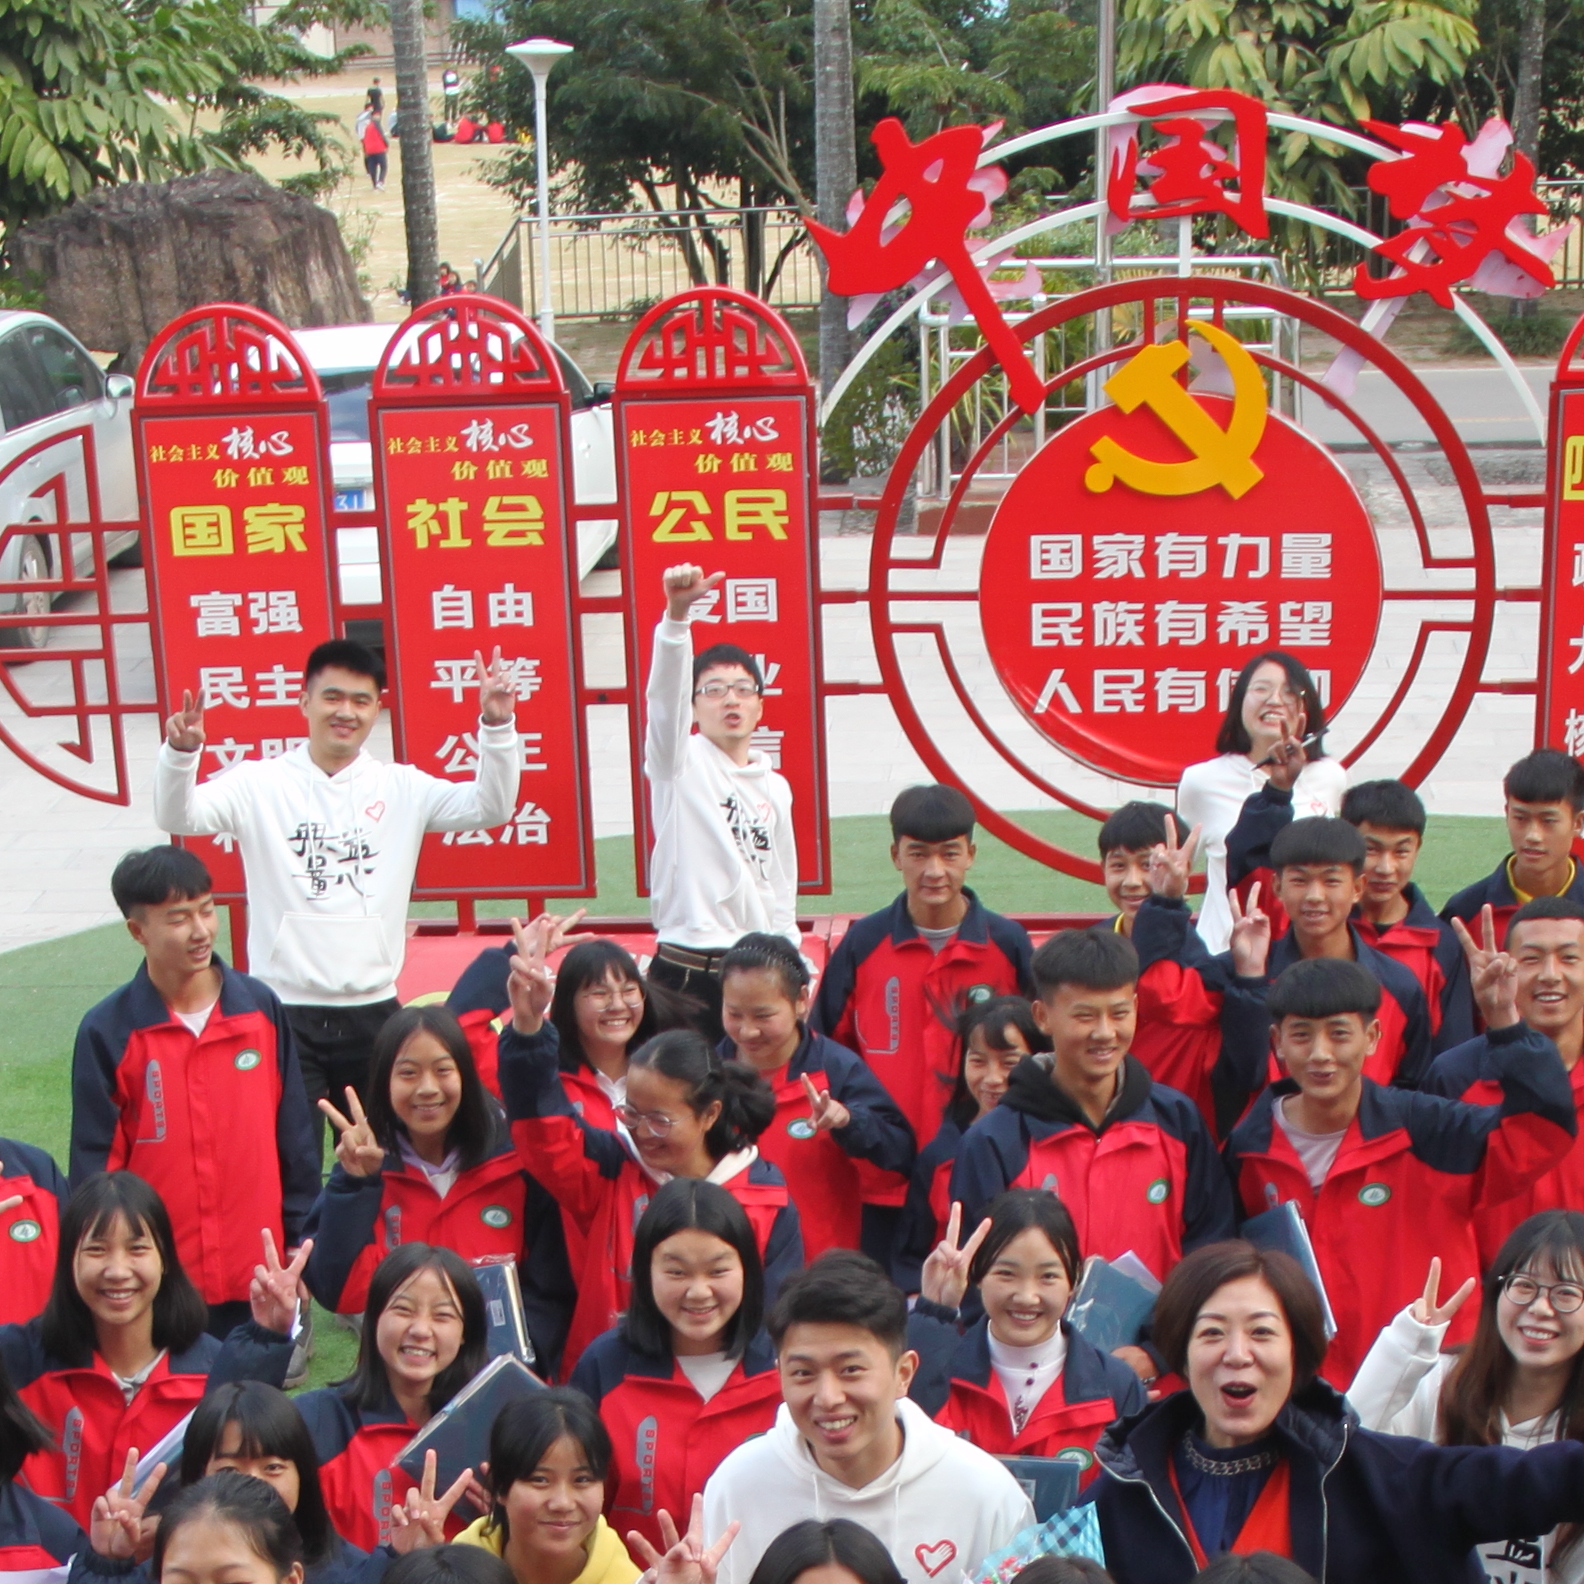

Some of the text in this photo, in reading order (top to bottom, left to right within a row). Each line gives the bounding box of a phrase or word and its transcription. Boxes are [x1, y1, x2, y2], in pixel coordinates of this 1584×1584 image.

[212, 465, 311, 489] 价值观
[450, 458, 550, 481] 价值观
[694, 452, 794, 474] 价值观
[169, 502, 308, 557] 国家
[406, 494, 546, 549] 社会
[649, 488, 790, 543] 公民
[1030, 533, 1333, 580] 国家有力量
[189, 590, 304, 637] 富强
[432, 582, 535, 630] 自由
[1031, 600, 1333, 647] 民族有希望
[199, 663, 305, 711] 民主
[1033, 667, 1332, 715] 人民有
